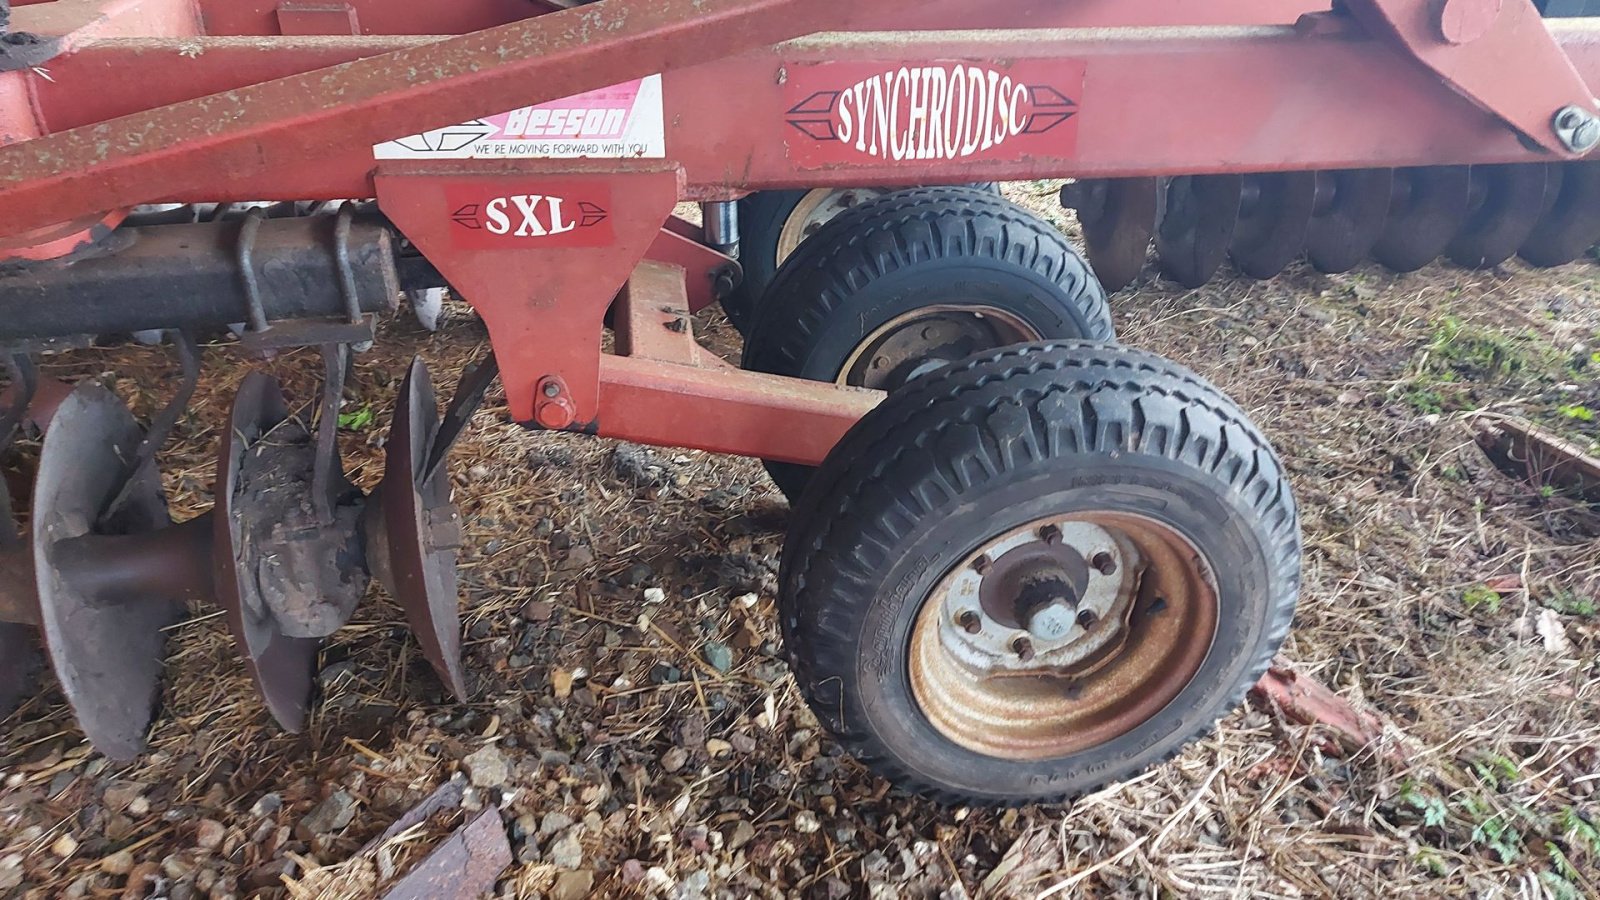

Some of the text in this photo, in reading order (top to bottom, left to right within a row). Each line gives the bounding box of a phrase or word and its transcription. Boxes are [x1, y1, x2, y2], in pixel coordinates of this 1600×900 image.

[502, 106, 627, 136] Besson
[837, 64, 1028, 161] SYNCHRODISC
[509, 144, 550, 155] MOVING
[553, 144, 599, 155] FORWARD
[602, 144, 625, 155] WITH
[628, 143, 648, 155] YOU
[485, 194, 576, 237] SXL
